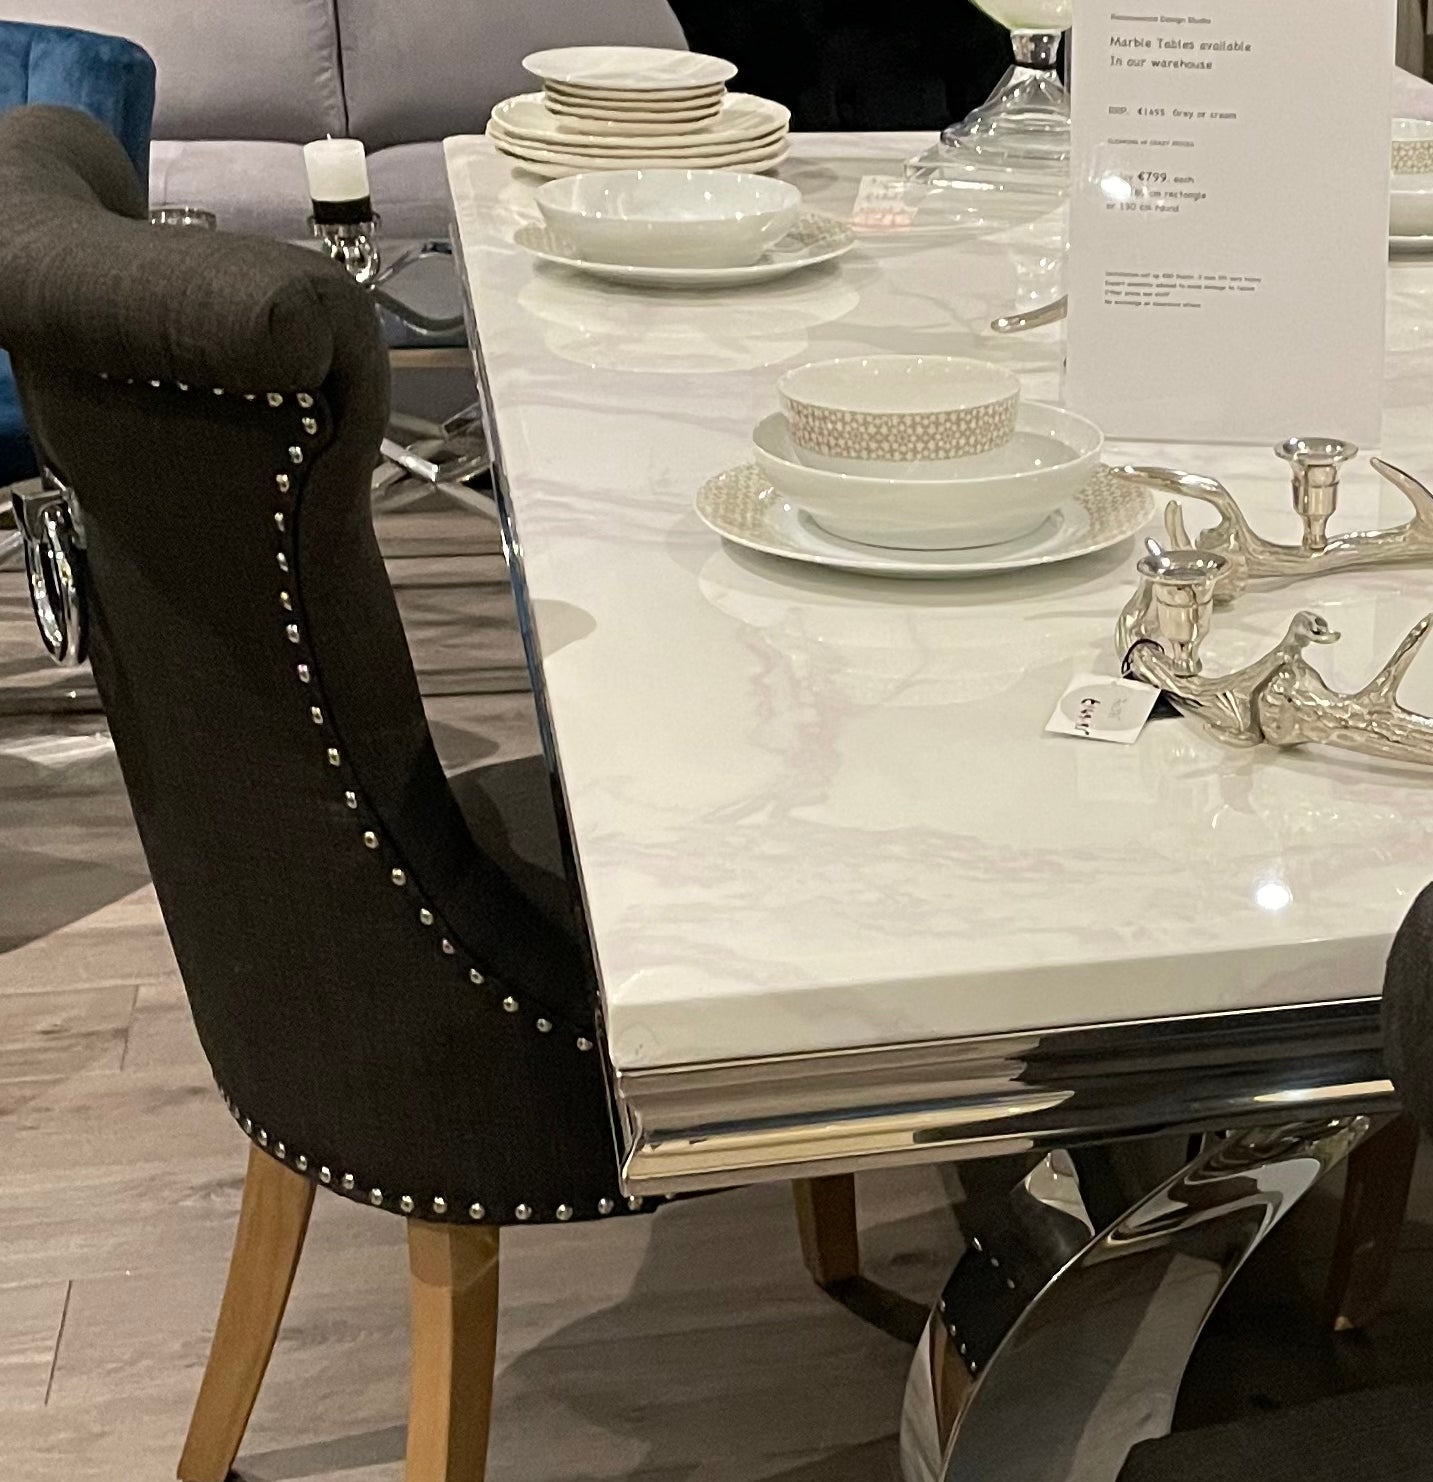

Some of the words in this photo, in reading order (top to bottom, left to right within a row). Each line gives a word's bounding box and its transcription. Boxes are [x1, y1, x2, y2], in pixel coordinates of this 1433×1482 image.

[1109, 36, 1152, 49] Marble
[1157, 38, 1195, 50] Tables
[1199, 41, 1252, 52] available
[1110, 55, 1123, 67] In
[1126, 58, 1147, 67] our
[1151, 58, 1213, 70] warehouse
[1164, 190, 1207, 202] rectangle
